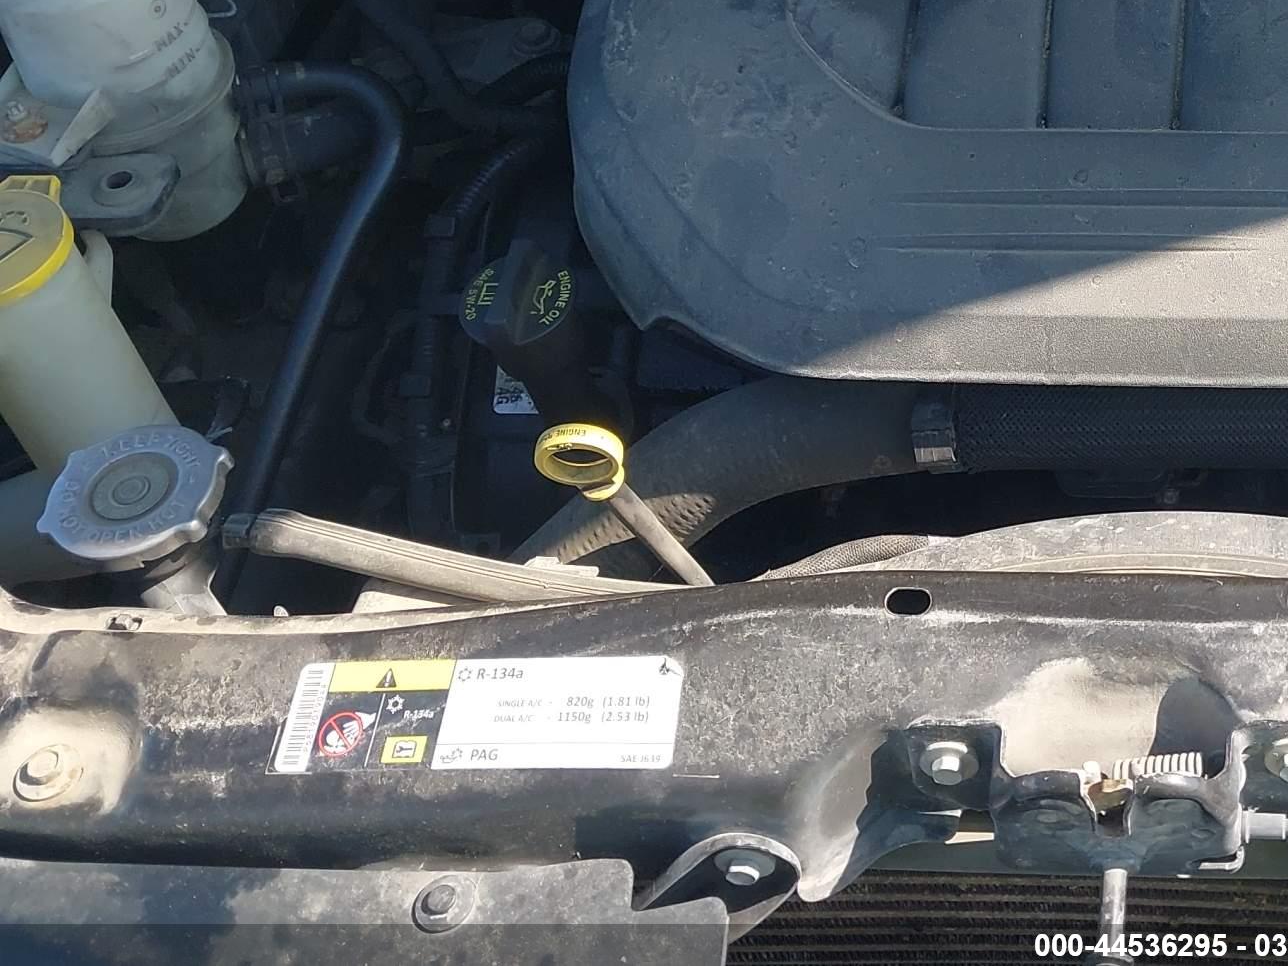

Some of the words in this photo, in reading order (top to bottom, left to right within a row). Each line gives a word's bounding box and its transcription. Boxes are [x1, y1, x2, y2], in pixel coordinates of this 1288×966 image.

[555, 270, 571, 308] ENGINE
[538, 311, 560, 325] OIL
[476, 668, 524, 680] R-134a
[496, 698, 525, 708] SINGLE
[528, 698, 542, 708] A/C
[566, 696, 594, 708] 820g
[602, 696, 630, 708] (1.81
[633, 696, 650, 708] lb)
[403, 710, 435, 720] R-134a
[493, 714, 516, 723] DUAL
[519, 714, 534, 723] A/C
[557, 712, 592, 724] 1150g
[601, 711, 630, 724] (2.53
[632, 711, 650, 724] lb)
[470, 749, 498, 762] PAG
[620, 755, 637, 764] SAE
